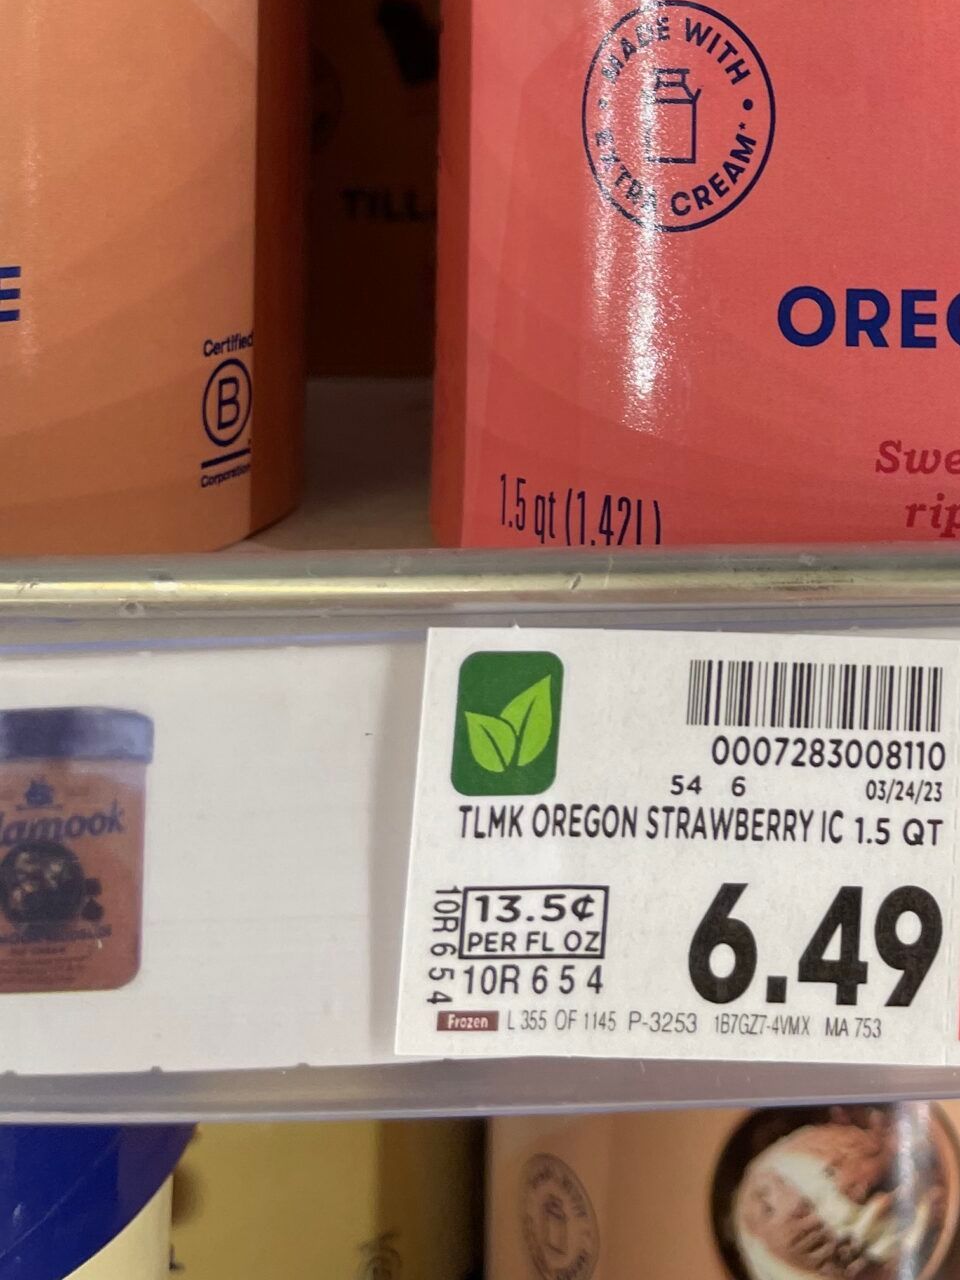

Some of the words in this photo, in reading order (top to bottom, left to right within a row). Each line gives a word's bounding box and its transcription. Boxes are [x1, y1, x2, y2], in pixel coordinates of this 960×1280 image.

[684, 16, 751, 86] WITH
[203, 331, 254, 358] Certified
[500, 472, 527, 532] 1.5
[533, 491, 557, 545] qt
[711, 734, 946, 772] 0007283008110
[669, 774, 703, 796] 54
[731, 775, 747, 797] 6
[865, 778, 943, 805] 03/24/23
[458, 803, 524, 839] TLMK
[531, 803, 638, 839] OREGON
[645, 805, 814, 843] STRAWBERRY
[821, 809, 844, 845] IC
[854, 816, 891, 845] 1.5
[902, 818, 944, 847] QT
[474, 894, 596, 923] 13.5¢
[467, 930, 517, 953] PER
[525, 930, 555, 952] FL
[563, 929, 601, 953] OZ
[687, 882, 944, 1008] 6.49
[464, 963, 520, 996] 10R
[447, 1011, 490, 1032] Frozen
[505, 1010, 516, 1031] L
[519, 1009, 548, 1032] 355
[554, 1009, 578, 1032] OF
[583, 1010, 617, 1033] 1145
[628, 1011, 698, 1034] P-3253
[824, 1017, 850, 1037] MA
[855, 1017, 883, 1039] 753
